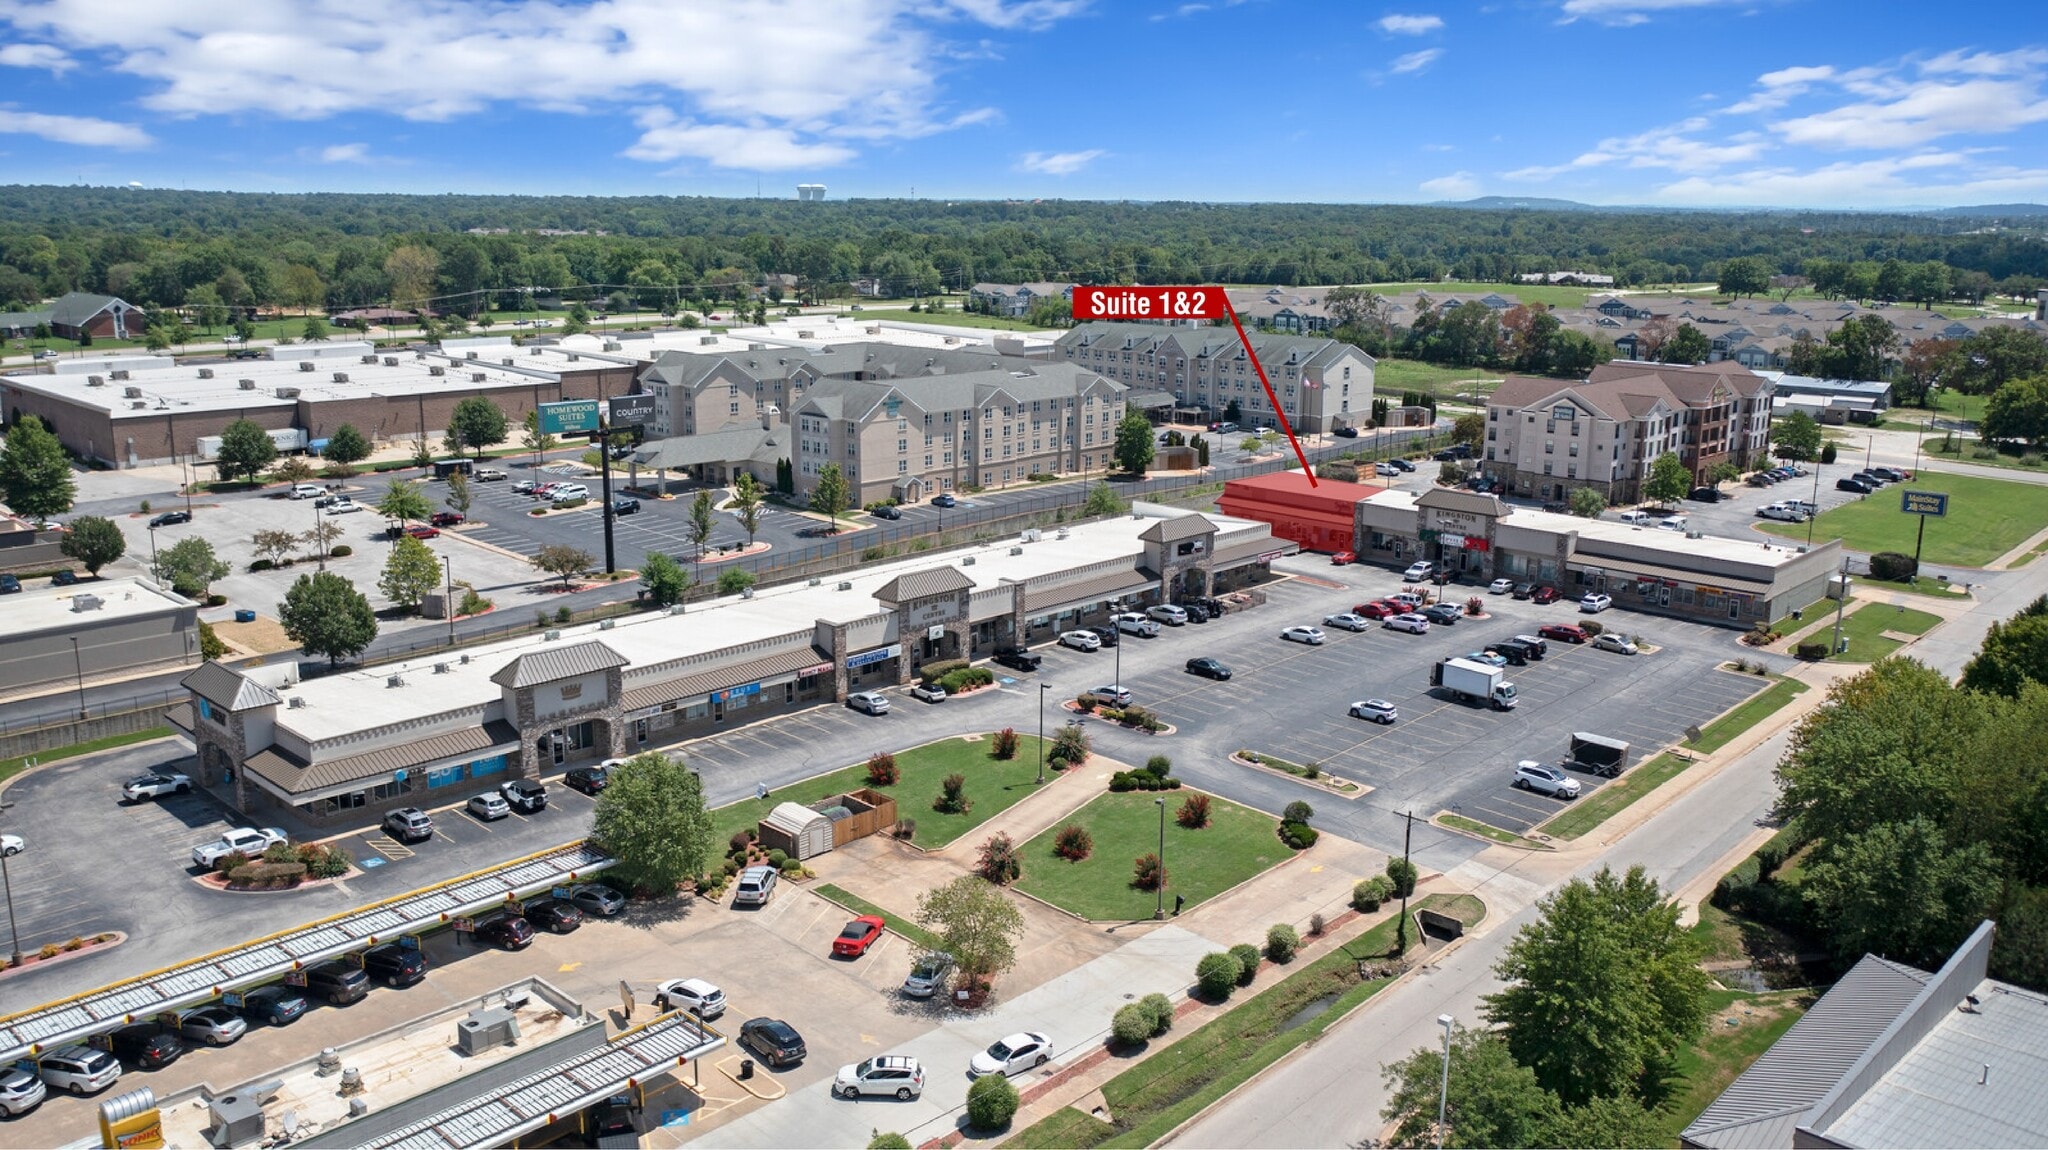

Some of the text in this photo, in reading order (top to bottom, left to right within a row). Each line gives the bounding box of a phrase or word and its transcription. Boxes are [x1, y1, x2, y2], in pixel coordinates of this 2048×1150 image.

[547, 404, 595, 415] HOMEWOOD
[616, 406, 653, 417] COUNTRY
[558, 412, 586, 422] SUITES
[1436, 510, 1477, 523] KINGSTON
[913, 592, 956, 612] KINGSTON
[922, 609, 946, 621] CENTRE
[121, 1127, 159, 1147] SONIC
